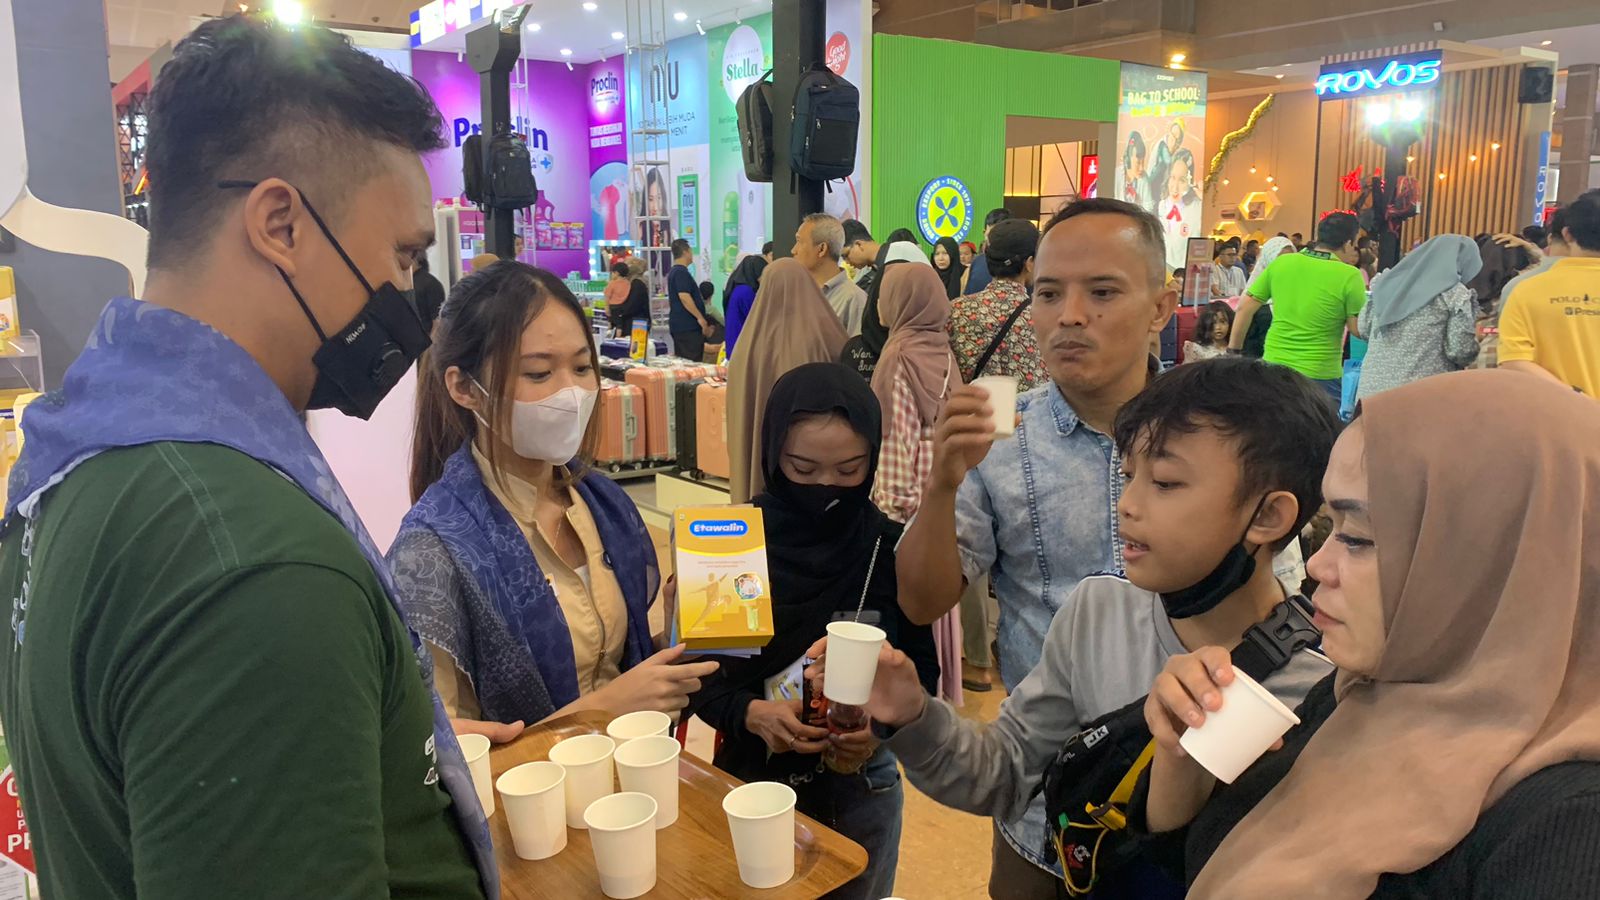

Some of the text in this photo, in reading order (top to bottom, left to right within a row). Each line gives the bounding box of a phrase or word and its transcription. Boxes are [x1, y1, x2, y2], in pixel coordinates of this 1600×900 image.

[726, 57, 759, 81] Stella
[1316, 60, 1441, 95] ROVOS
[591, 72, 618, 96] Proclin
[1128, 92, 1146, 105] BAG
[1149, 90, 1161, 103] TO
[1534, 166, 1547, 223] ROVO
[694, 523, 744, 533] Etawalin
[1090, 728, 1107, 743] JK
